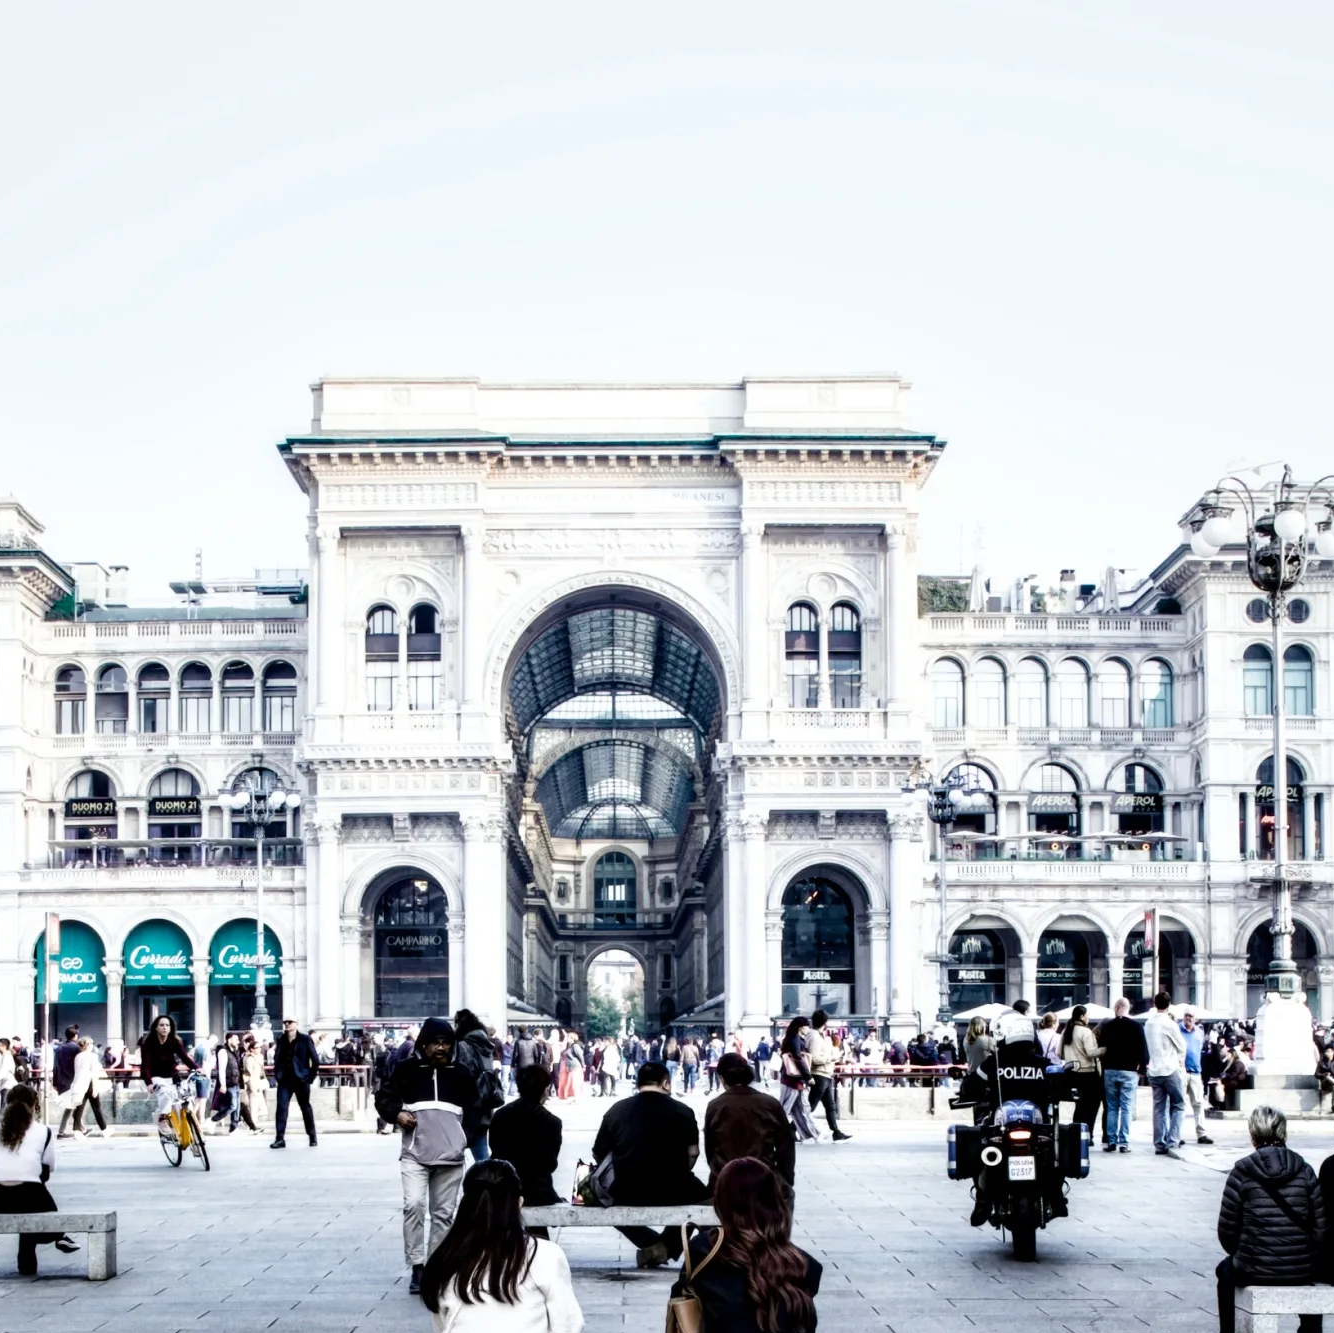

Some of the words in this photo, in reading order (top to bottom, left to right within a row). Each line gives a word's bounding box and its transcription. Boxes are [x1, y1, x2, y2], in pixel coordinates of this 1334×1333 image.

[1257, 786, 1298, 798] APOL
[71, 802, 103, 811] DUOMO
[104, 802, 113, 811] 21
[155, 801, 187, 810] DUOMO
[187, 800, 197, 809] 21
[1031, 795, 1073, 807] APEROL
[1114, 795, 1156, 807] APEROL
[386, 935, 442, 946] CAMPARINO
[130, 945, 186, 969] Currado
[803, 970, 831, 980] Motta
[958, 970, 986, 979] Motta
[997, 1066, 1044, 1080] POLIZIA
[1011, 1167, 1033, 1177] G2317
